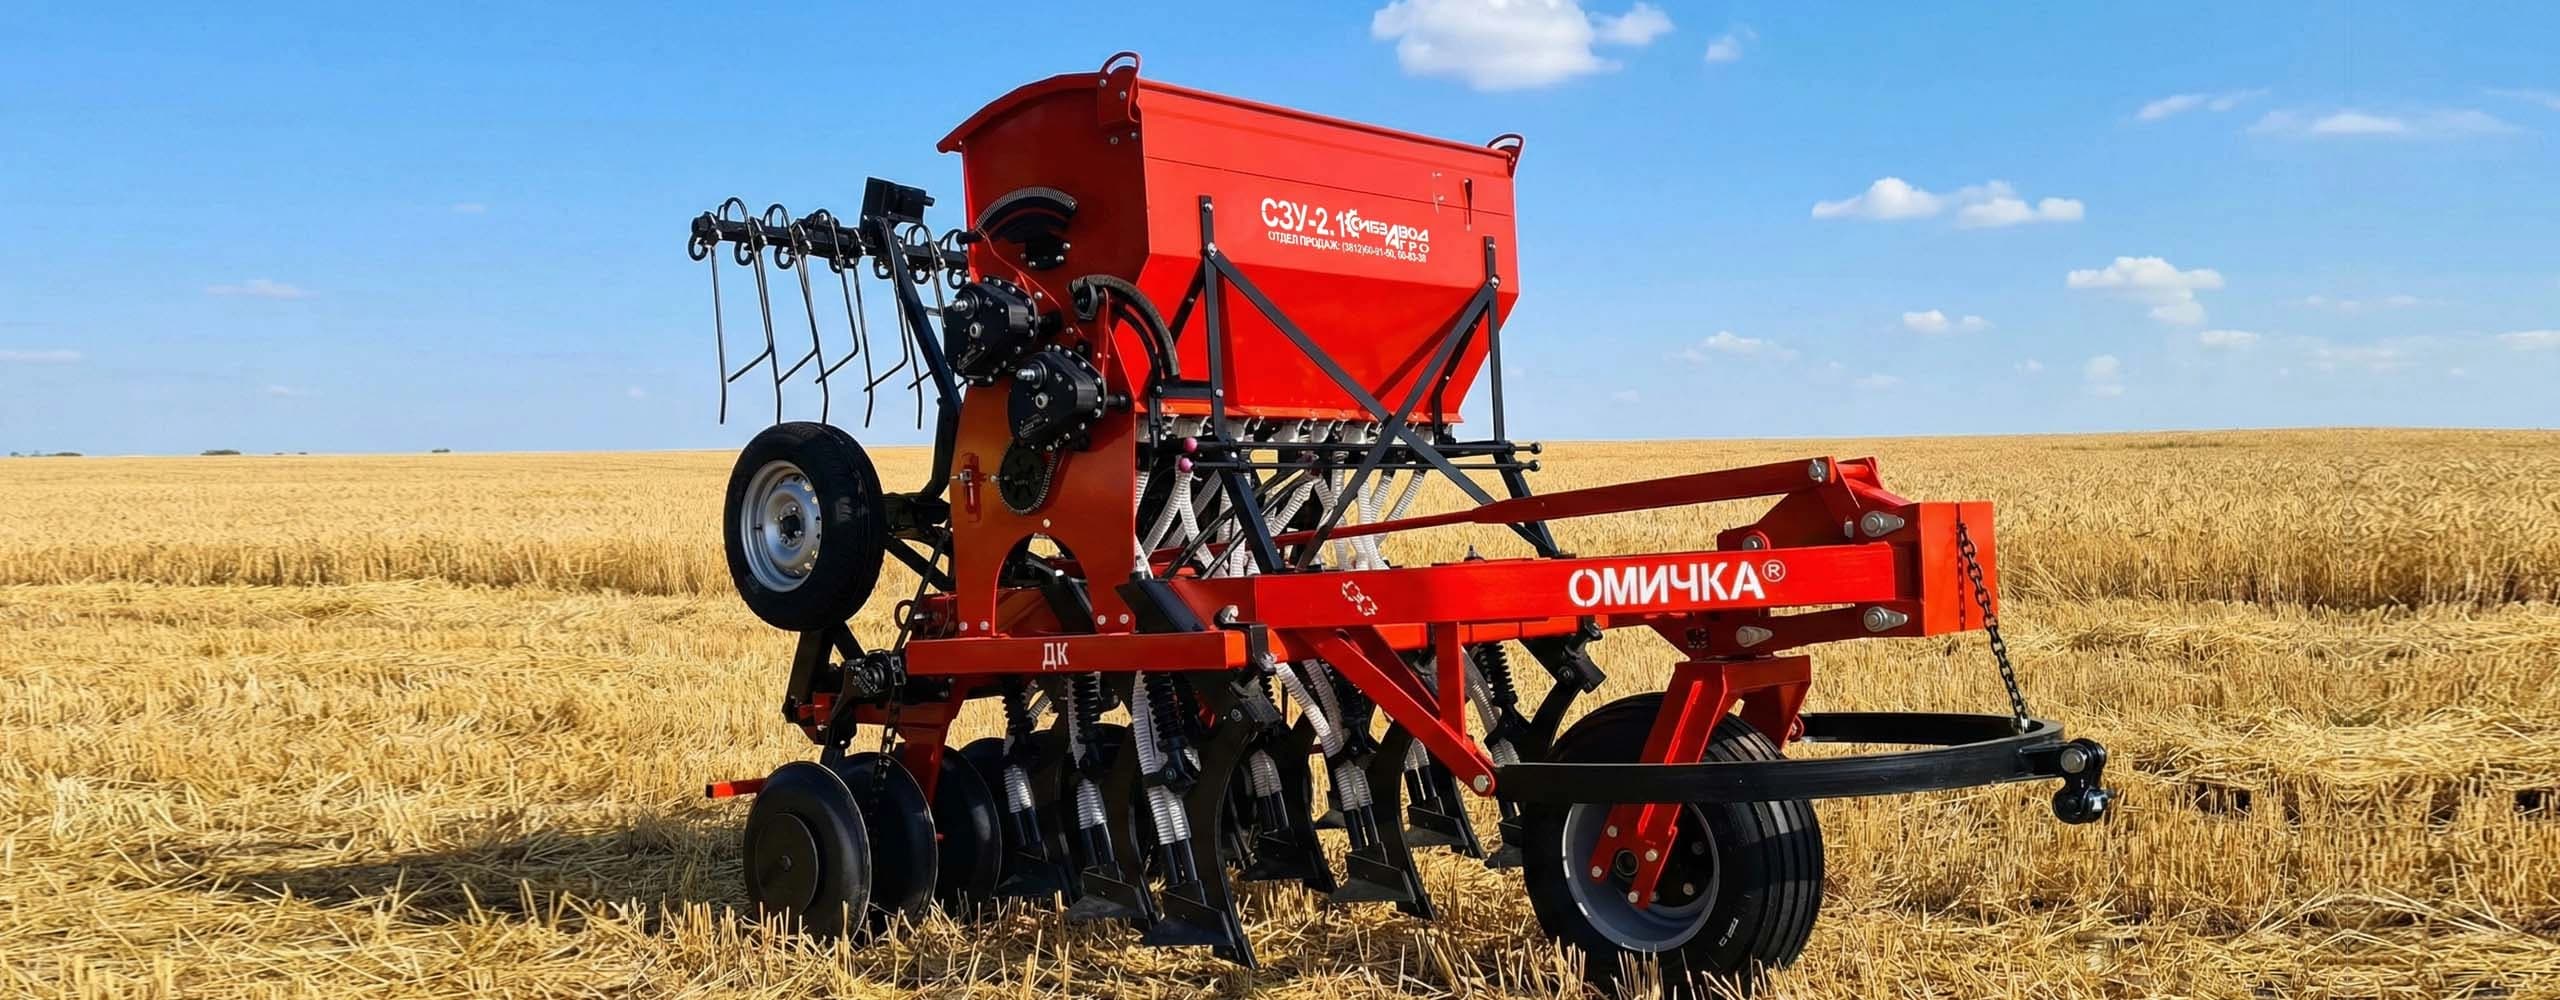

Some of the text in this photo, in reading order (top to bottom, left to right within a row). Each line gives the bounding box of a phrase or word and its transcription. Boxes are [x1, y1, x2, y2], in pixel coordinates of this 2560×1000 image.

[1268, 231, 1298, 245] ОТДЕЛ
[1301, 235, 1340, 250] ПРОДАЖ:
[1042, 642, 1069, 671] ДК
